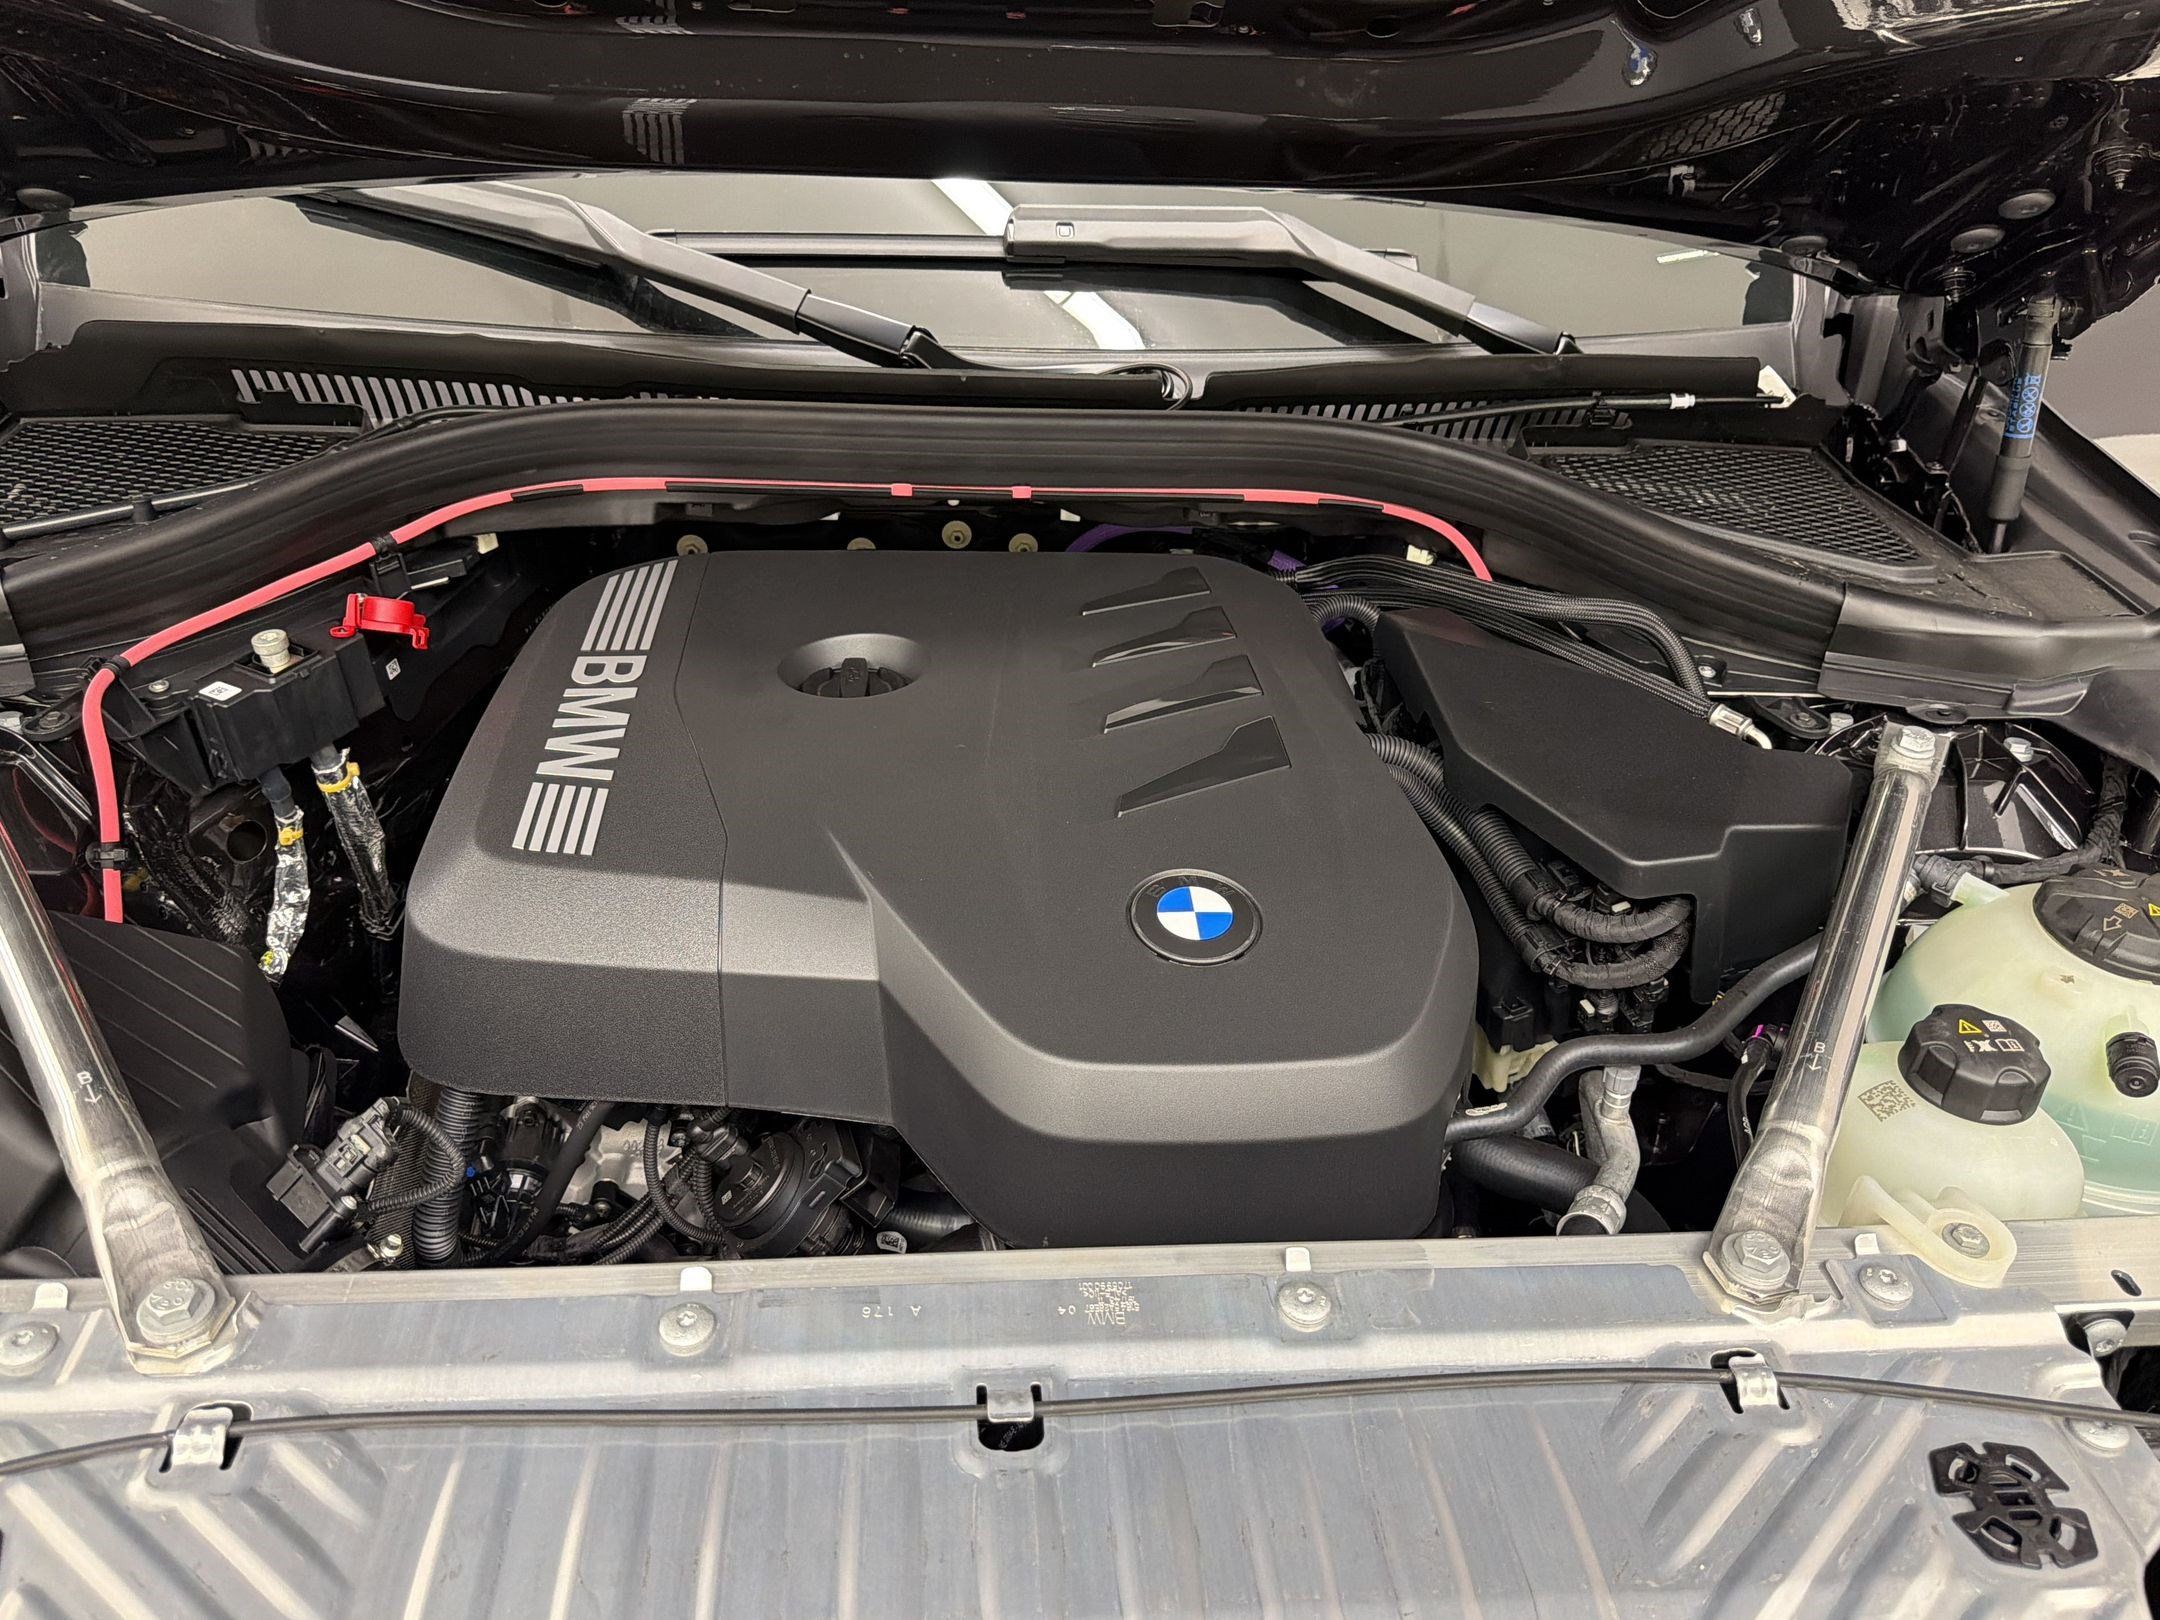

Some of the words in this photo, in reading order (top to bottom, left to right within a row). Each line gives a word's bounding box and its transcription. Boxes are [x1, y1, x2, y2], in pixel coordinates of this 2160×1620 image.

[2009, 377, 2023, 432] STABILUS
[536, 655, 647, 781] BMW
[1814, 1042, 1826, 1053] B
[77, 1071, 92, 1085] B
[910, 1305, 922, 1316] A
[1088, 1311, 1126, 1325] BMW
